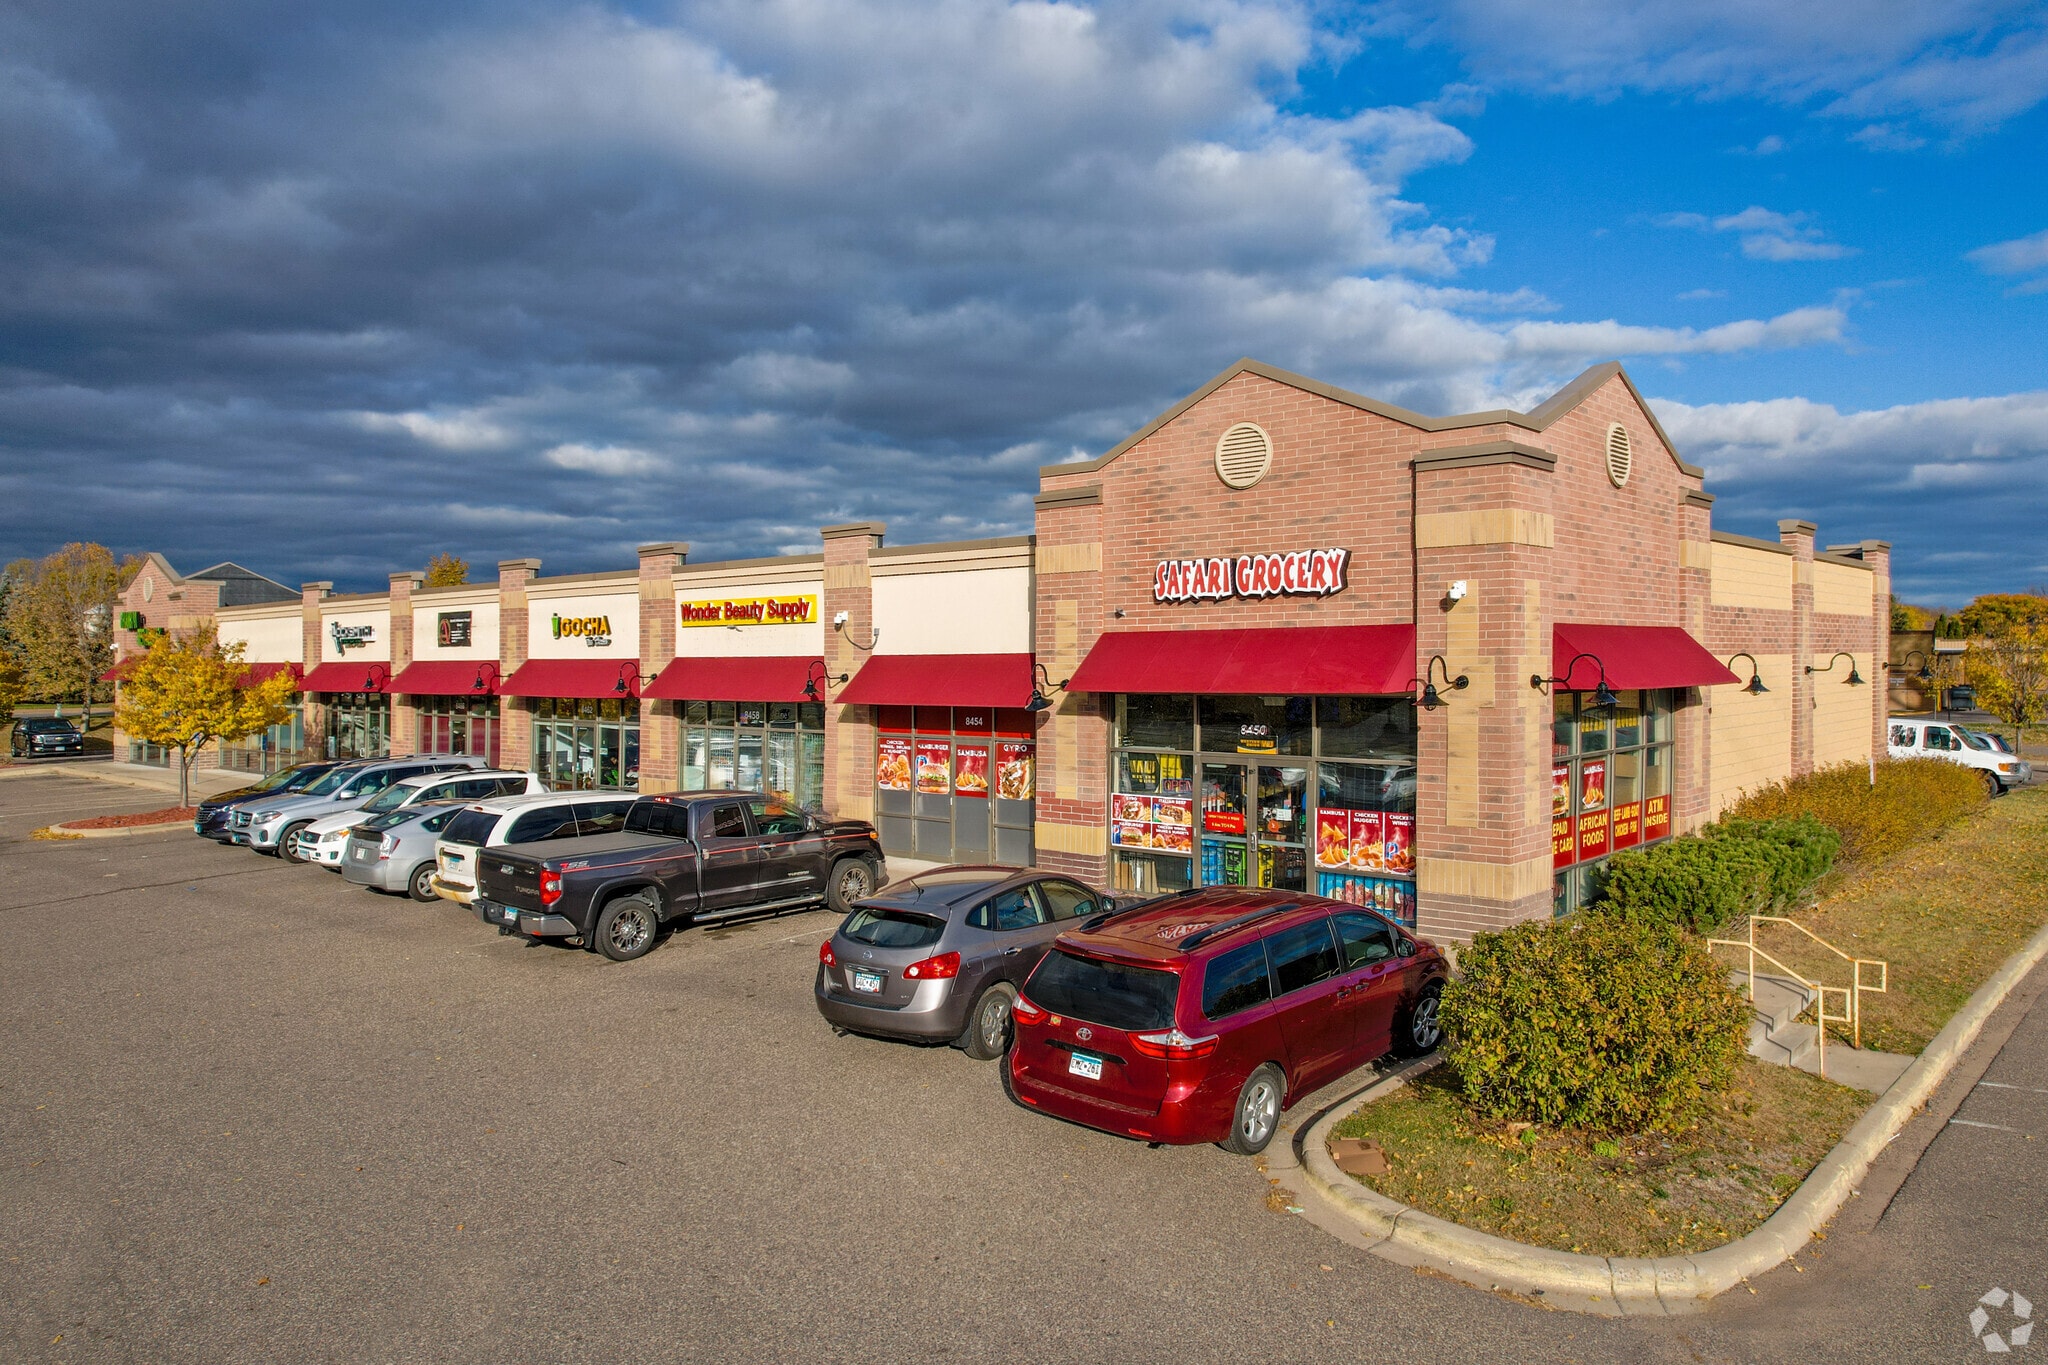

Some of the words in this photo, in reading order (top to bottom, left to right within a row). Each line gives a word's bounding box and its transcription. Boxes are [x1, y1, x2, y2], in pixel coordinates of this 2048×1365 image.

[1155, 557, 1232, 601] SAFARI
[1236, 548, 1346, 598] GROCERY
[681, 603, 721, 622] Wonder
[724, 600, 764, 623] Beauty
[767, 598, 809, 622] Supply
[965, 717, 983, 726] 8454
[1240, 724, 1268, 735] 8450
[1003, 744, 1028, 752] GYRO
[1164, 780, 1192, 792] OPEN
[1647, 798, 1664, 815] ATM
[1552, 820, 1567, 837] EPAID
[1579, 813, 1607, 832] AFRICAN
[1644, 812, 1668, 828] INSIDE
[1582, 830, 1605, 847] FOODS
